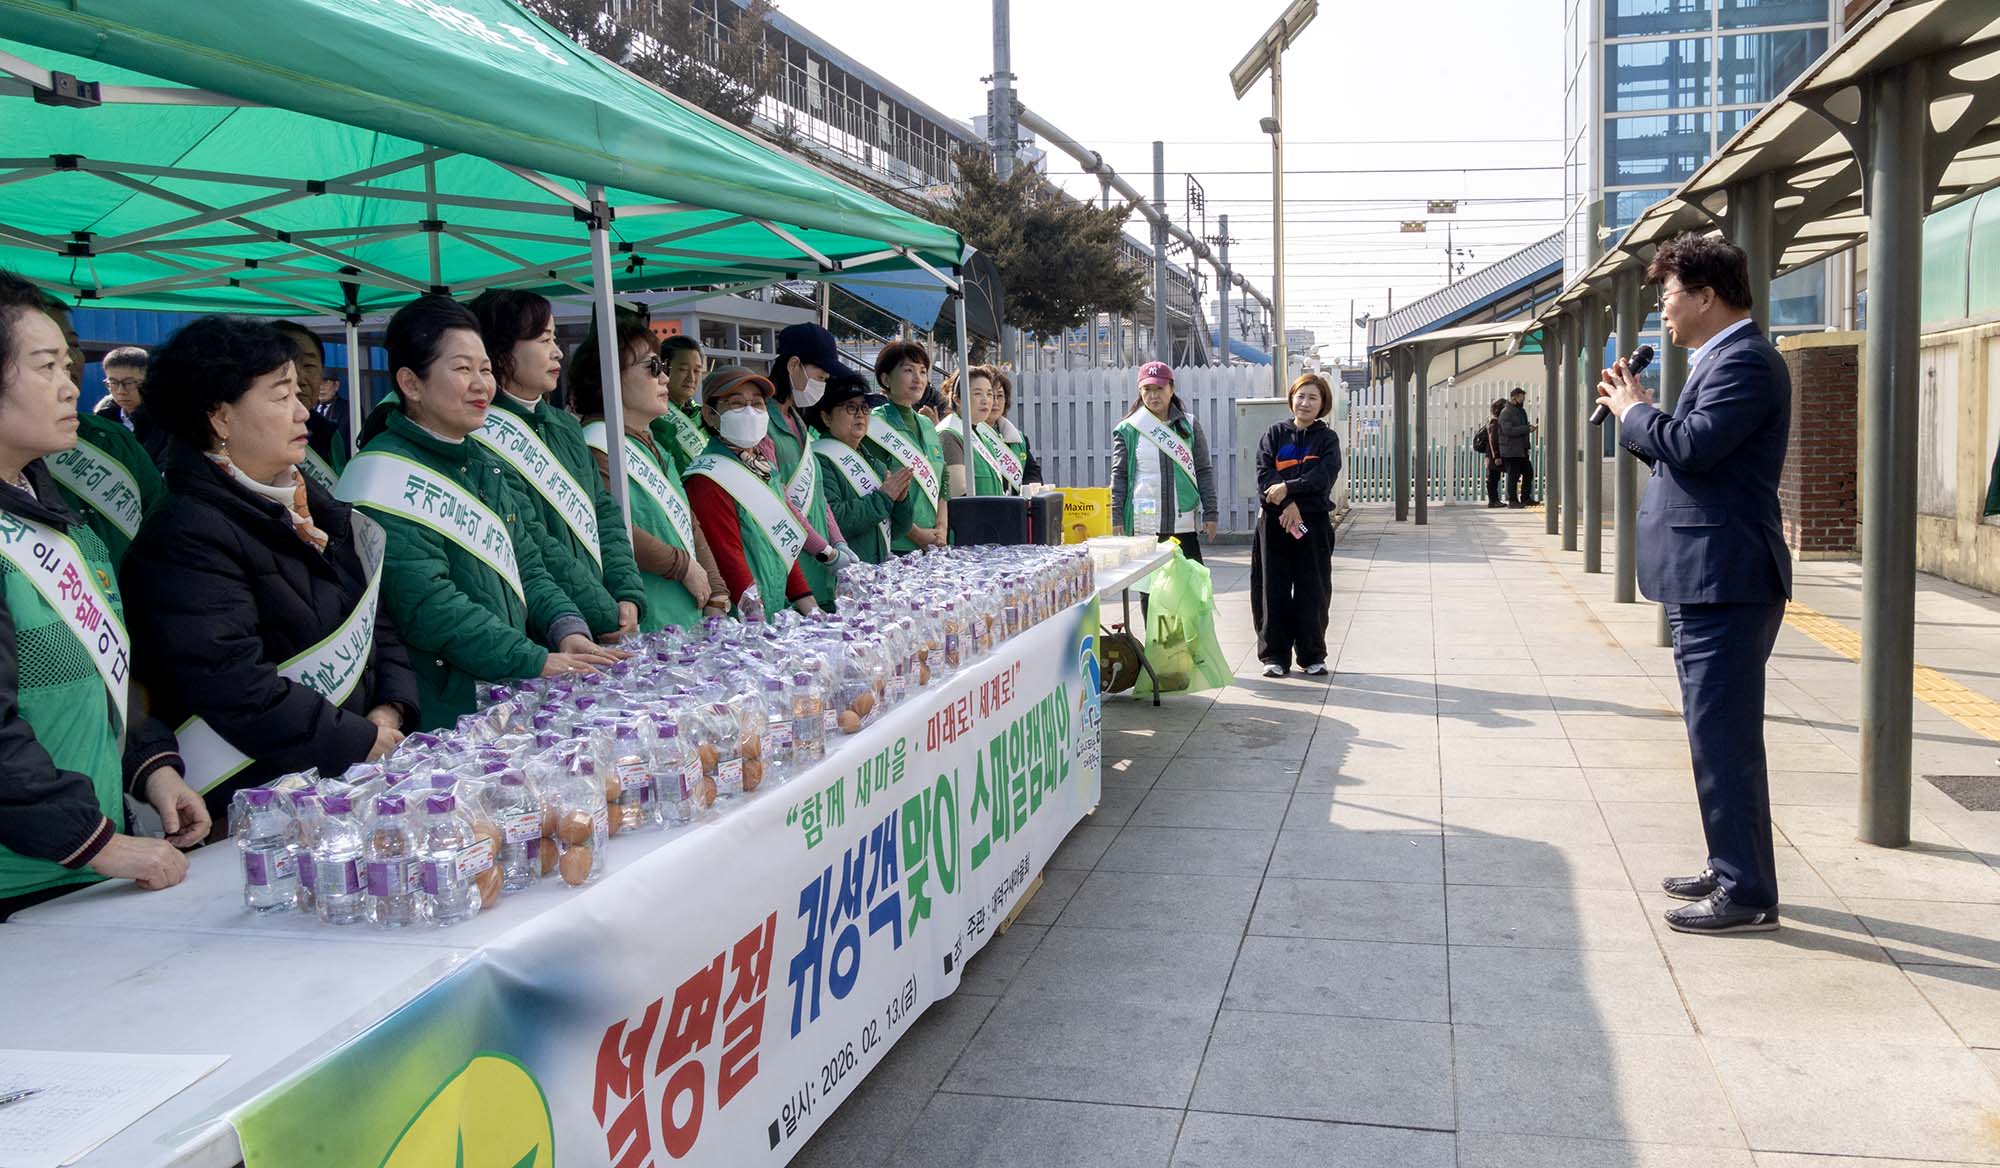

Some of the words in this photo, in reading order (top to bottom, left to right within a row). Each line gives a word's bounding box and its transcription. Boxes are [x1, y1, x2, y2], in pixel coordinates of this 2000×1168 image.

[404, 474, 482, 542] 세계일류의
[1064, 503, 1094, 512] Maxim
[855, 736, 907, 809] 새마을
[926, 690, 974, 752] 미래로!
[591, 910, 778, 1168] 설명절
[970, 681, 1071, 871] 스마일캠페인
[821, 1041, 859, 1096] 2026.
[862, 1019, 882, 1054] 02.
[885, 973, 918, 1030] 13.(금)
